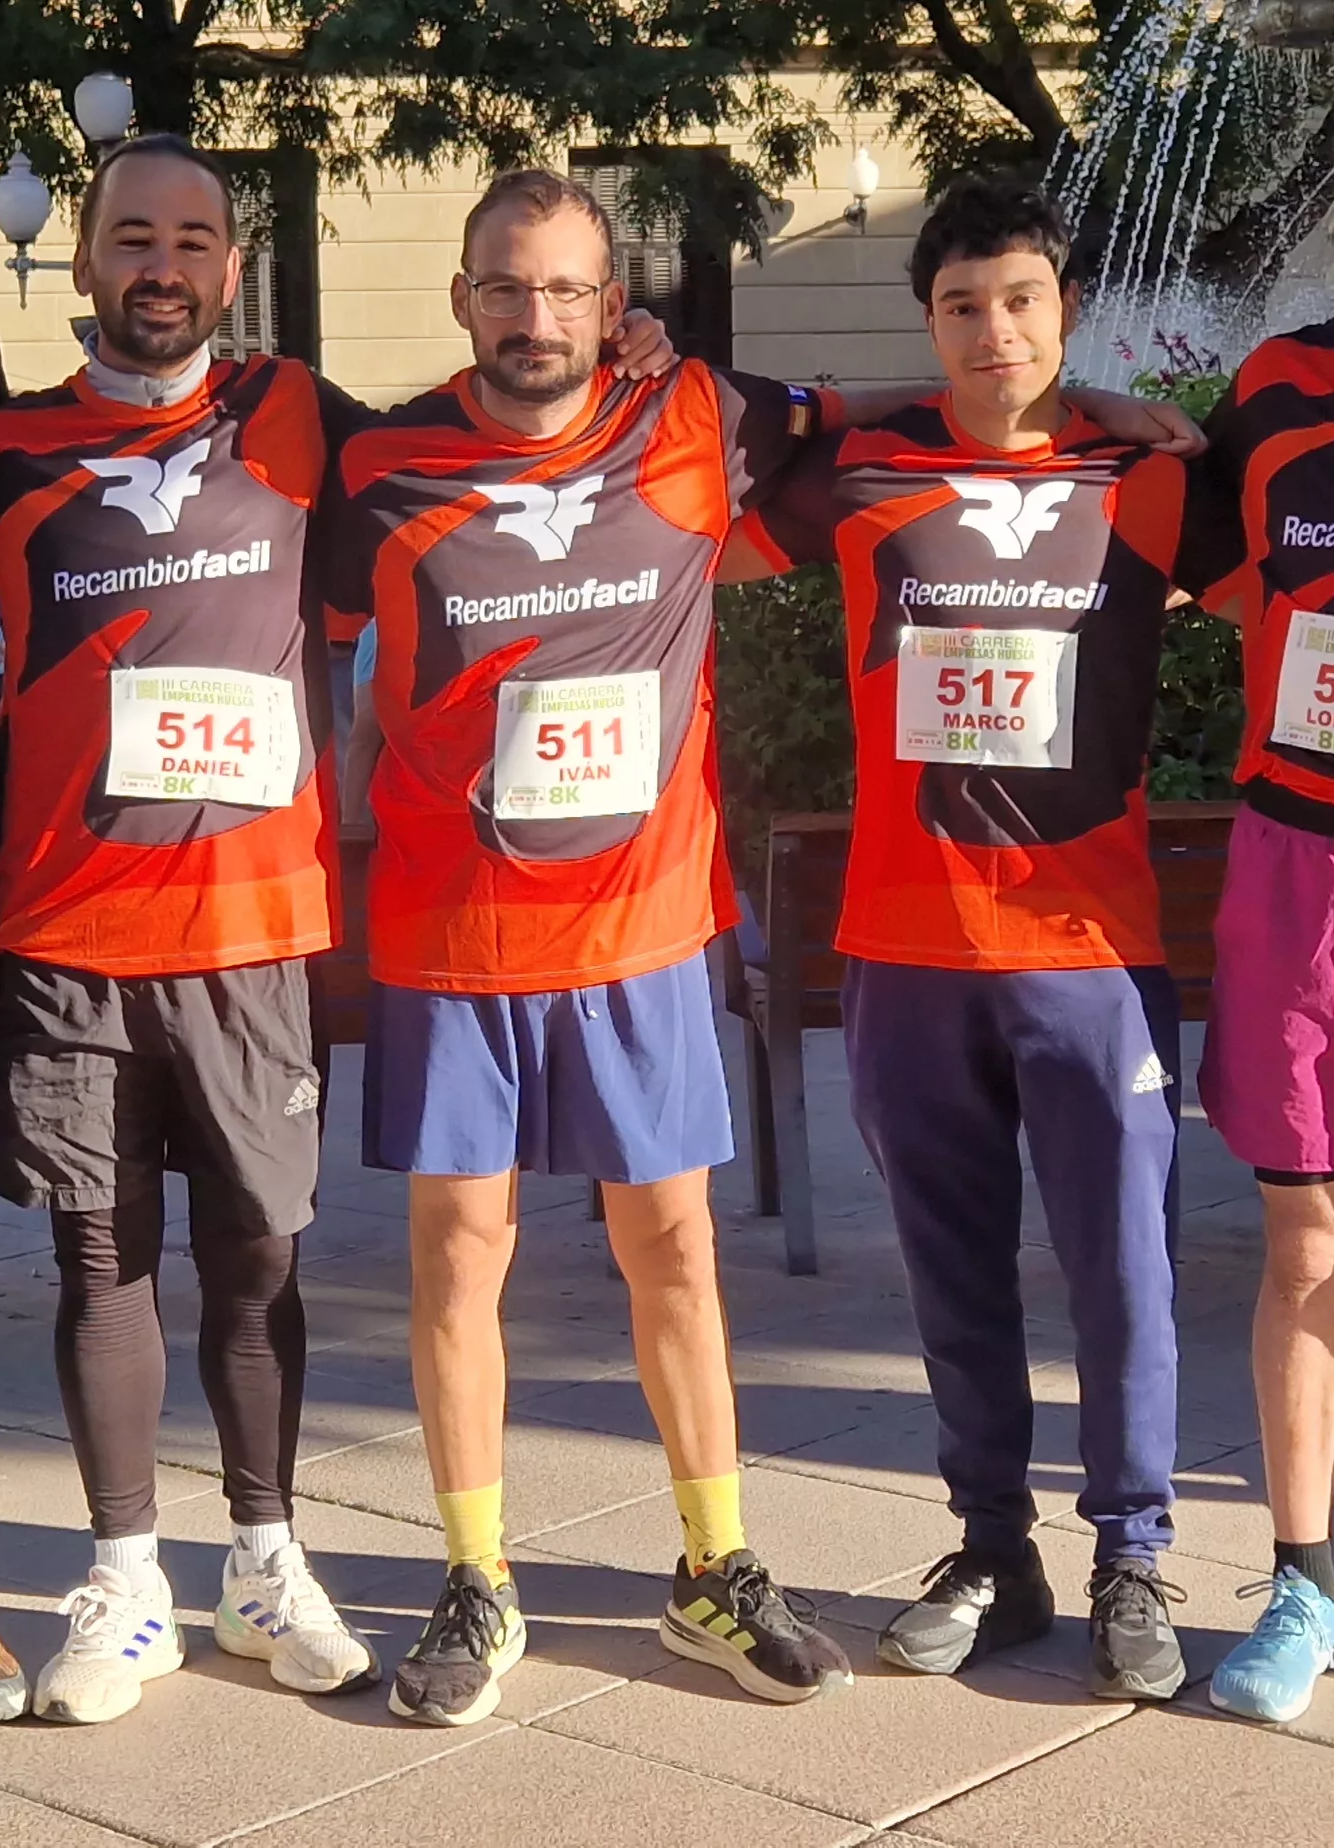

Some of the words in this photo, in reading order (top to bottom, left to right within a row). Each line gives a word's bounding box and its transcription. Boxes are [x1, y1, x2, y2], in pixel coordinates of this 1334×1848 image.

[53, 540, 271, 602] Recambiofacil
[445, 568, 660, 627] Recambiofacil
[898, 577, 1109, 611] Recambiofacil
[943, 635, 956, 647] III
[960, 635, 1035, 649] CARRERA
[943, 646, 995, 659] EMPRESAS
[997, 648, 1035, 660] HUESCA
[161, 679, 175, 690] III
[179, 679, 253, 695] CARRERA
[541, 689, 554, 701] III
[558, 684, 625, 700] CARRERA
[936, 668, 1035, 708] 517
[162, 690, 215, 704] EMPRESAS
[217, 694, 255, 707] HUESCA
[541, 699, 591, 713] EMPRESAS
[943, 712, 1026, 731] MARCO
[156, 711, 256, 755] 514
[535, 717, 623, 761] 511
[946, 732, 979, 751] 8K
[161, 757, 245, 777] DANIEL
[559, 761, 611, 782] IVÁN
[162, 776, 196, 794] 8K
[549, 785, 581, 805] 8K
[284, 1095, 319, 1116] adida
